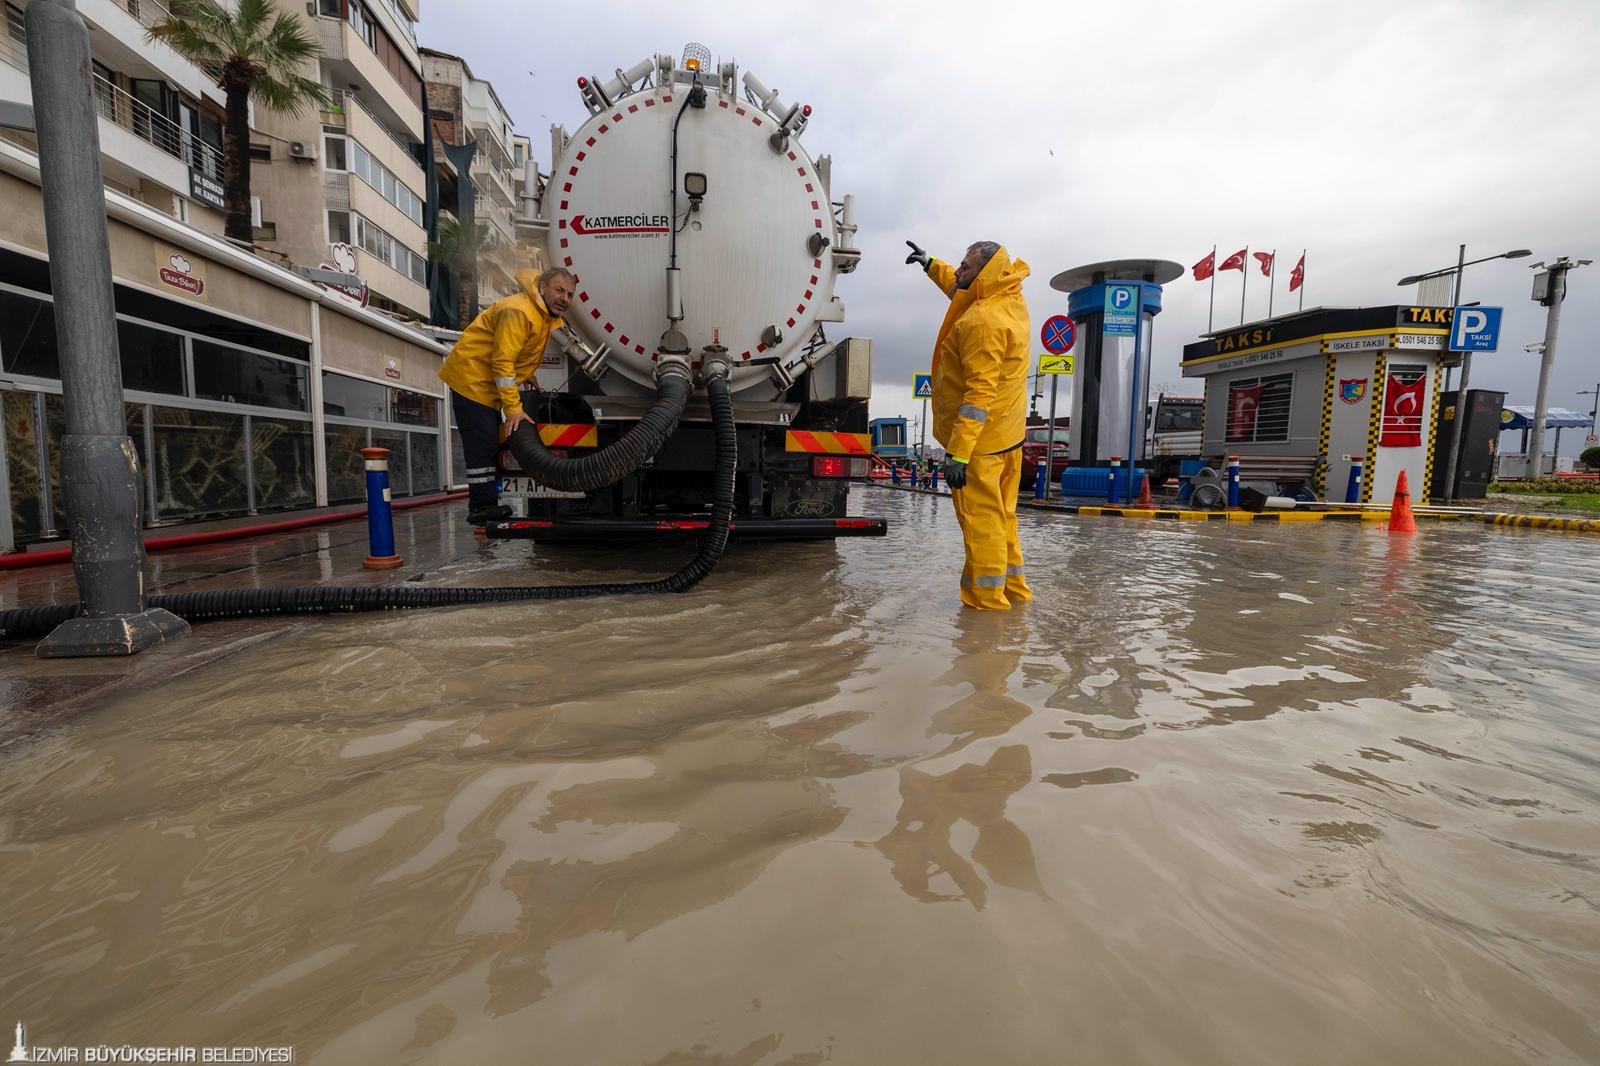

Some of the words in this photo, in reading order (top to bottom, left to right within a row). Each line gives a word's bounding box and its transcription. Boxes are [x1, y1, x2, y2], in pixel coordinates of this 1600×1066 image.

[585, 212, 669, 229] KATMERCİLER
[594, 233, 660, 241] www.katmerciler.com.tr
[1116, 290, 1129, 307] P
[1410, 307, 1454, 323] TAKS
[1457, 310, 1487, 347] P
[1333, 342, 1361, 351] İSKELE
[1362, 340, 1385, 349] TAKSİ
[1402, 336, 1415, 344] 0501
[1416, 337, 1427, 345] 546
[1436, 338, 1443, 346] 50
[503, 478, 519, 492] 21
[795, 501, 825, 515] Ford
